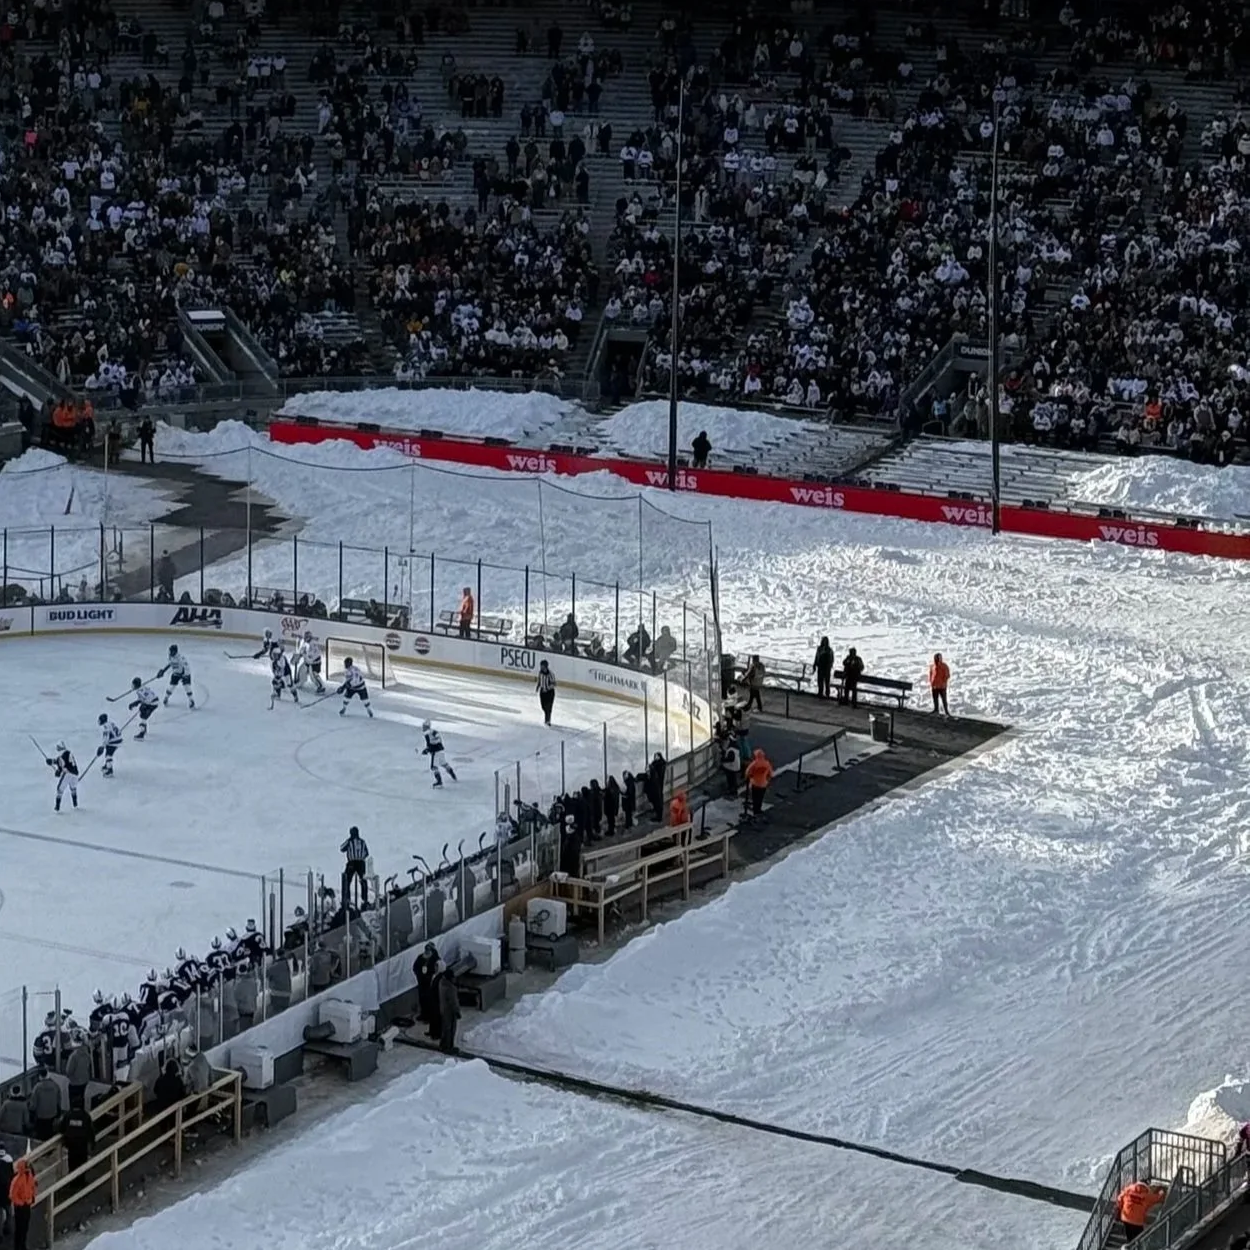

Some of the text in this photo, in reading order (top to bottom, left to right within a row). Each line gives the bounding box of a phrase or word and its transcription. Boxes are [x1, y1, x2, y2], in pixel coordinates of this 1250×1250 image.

[506, 454, 557, 472] weis
[790, 487, 845, 507] weis
[940, 504, 994, 526] weis
[1099, 525, 1159, 547] weis
[50, 609, 114, 621] BUD LIGHT
[501, 647, 536, 669] PSECU
